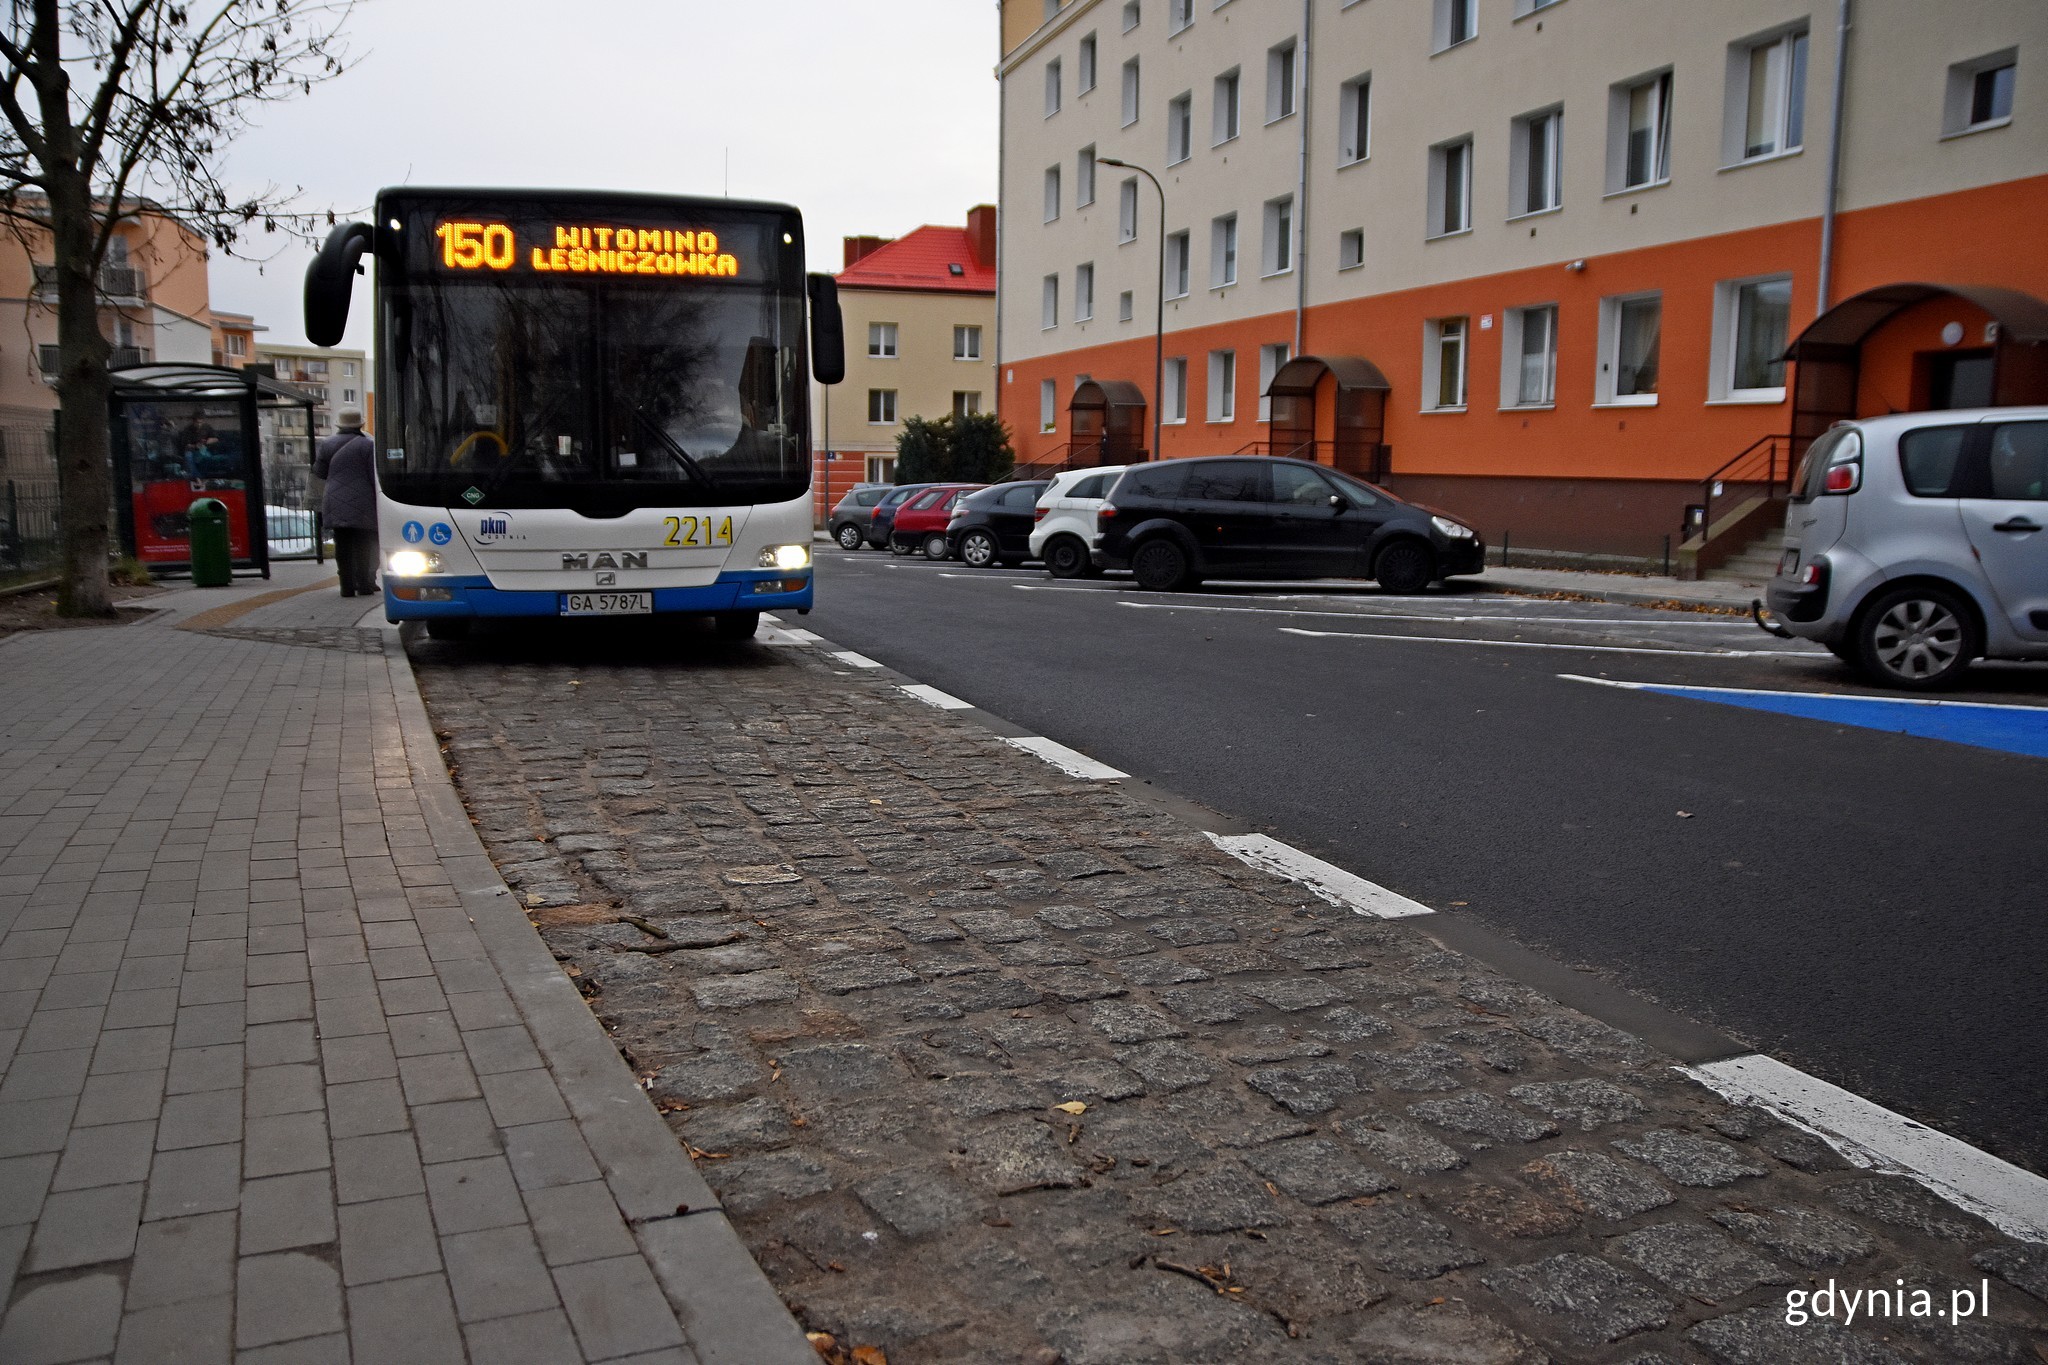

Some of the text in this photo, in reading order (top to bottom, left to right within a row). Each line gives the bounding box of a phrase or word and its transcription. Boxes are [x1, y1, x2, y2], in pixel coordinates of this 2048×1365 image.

[436, 222, 514, 269] 150
[556, 226, 718, 253] WITOMINO
[480, 516, 506, 536] pkm
[663, 516, 733, 546] 2214
[562, 551, 648, 569] MAN
[570, 595, 594, 611] GA
[599, 594, 649, 611] 5787L
